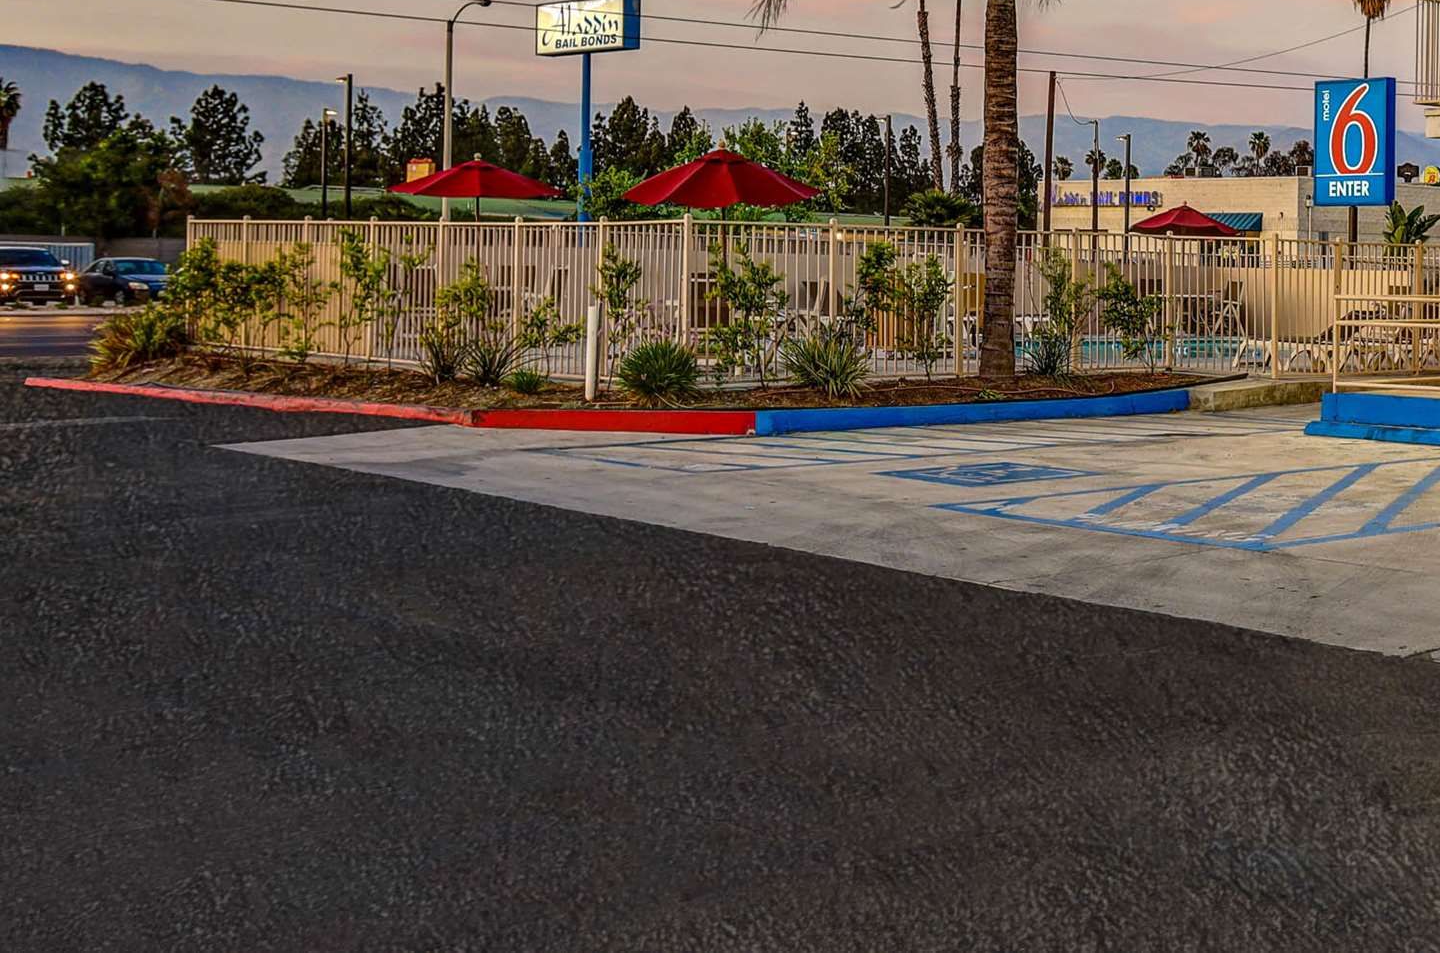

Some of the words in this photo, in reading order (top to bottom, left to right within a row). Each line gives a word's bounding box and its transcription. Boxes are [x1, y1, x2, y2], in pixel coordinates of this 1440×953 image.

[542, 4, 618, 46] Aladdin
[555, 38, 578, 49] BAIL
[581, 34, 617, 46] BONDS
[1322, 90, 1330, 121] motel
[1329, 83, 1378, 175] 6
[1328, 180, 1369, 197] ENTER
